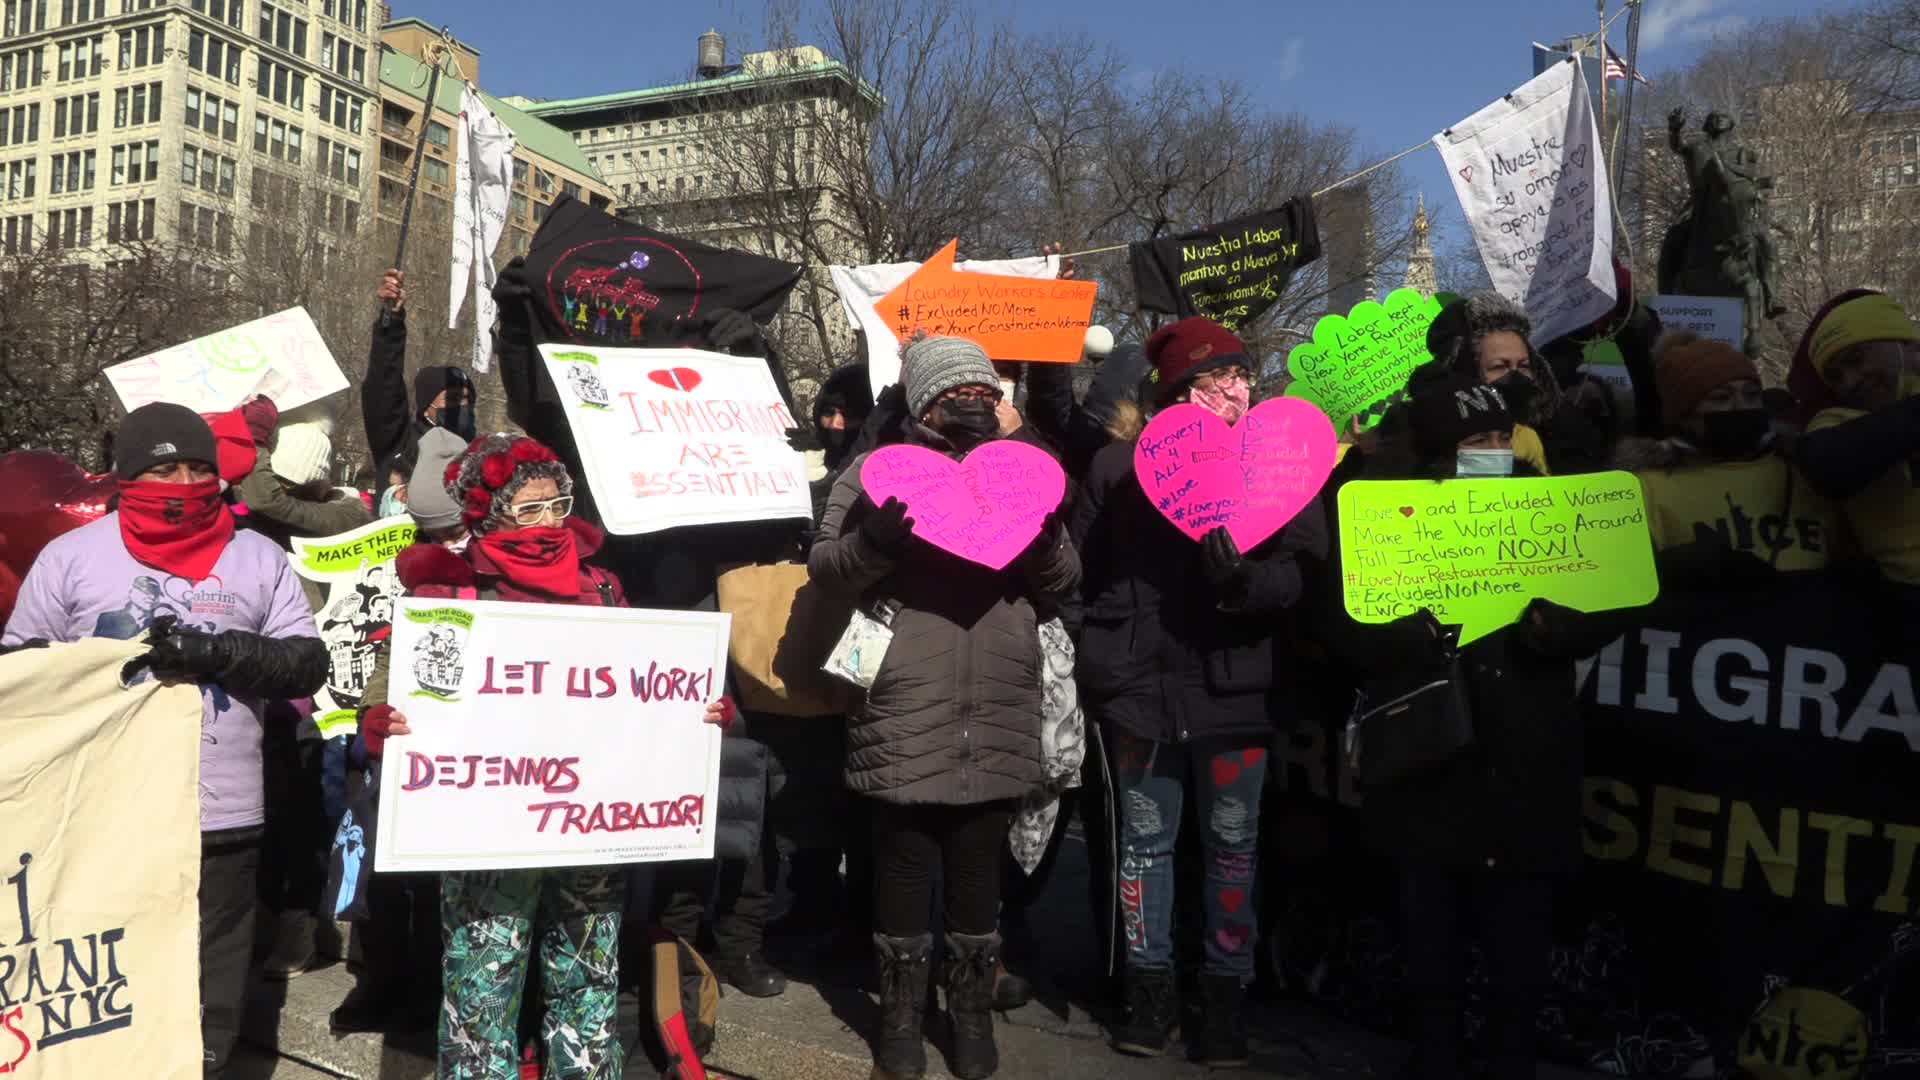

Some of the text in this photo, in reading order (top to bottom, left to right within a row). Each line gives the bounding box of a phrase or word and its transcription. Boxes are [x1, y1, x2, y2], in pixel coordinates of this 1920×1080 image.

[1491, 135, 1562, 186] Muestre
[1494, 191, 1516, 213] su
[1183, 228, 1283, 261] Nuestra Labor
[1180, 264, 1228, 287] mantuvo
[1232, 260, 1242, 271] a
[1243, 253, 1279, 271] Nueva
[903, 280, 970, 304] Laundry
[977, 283, 1046, 301] Workers
[1299, 302, 1415, 372] Our Labor kept
[1306, 363, 1338, 385] New
[1337, 344, 1369, 365] York
[1310, 378, 1339, 400] We
[1343, 346, 1393, 382] deserve
[679, 443, 752, 468] ARE
[1139, 417, 1204, 460] Recovery
[1168, 448, 1180, 459] 4
[1153, 459, 1184, 488] ALL
[1352, 486, 1636, 522] Love and Excluded Workers
[1353, 508, 1644, 547] Make the World Go Around
[316, 543, 364, 564] MAKE
[366, 529, 400, 552] THE
[1355, 534, 1585, 570] Full Inclusion NOW!
[182, 589, 236, 604] Cabrini
[450, 608, 473, 621] ROAD
[478, 656, 713, 704] LET US WORK!
[401, 751, 580, 793] DEJENNOS
[527, 794, 705, 835] TRABAJAR!
[35, 979, 133, 1039] NYC
